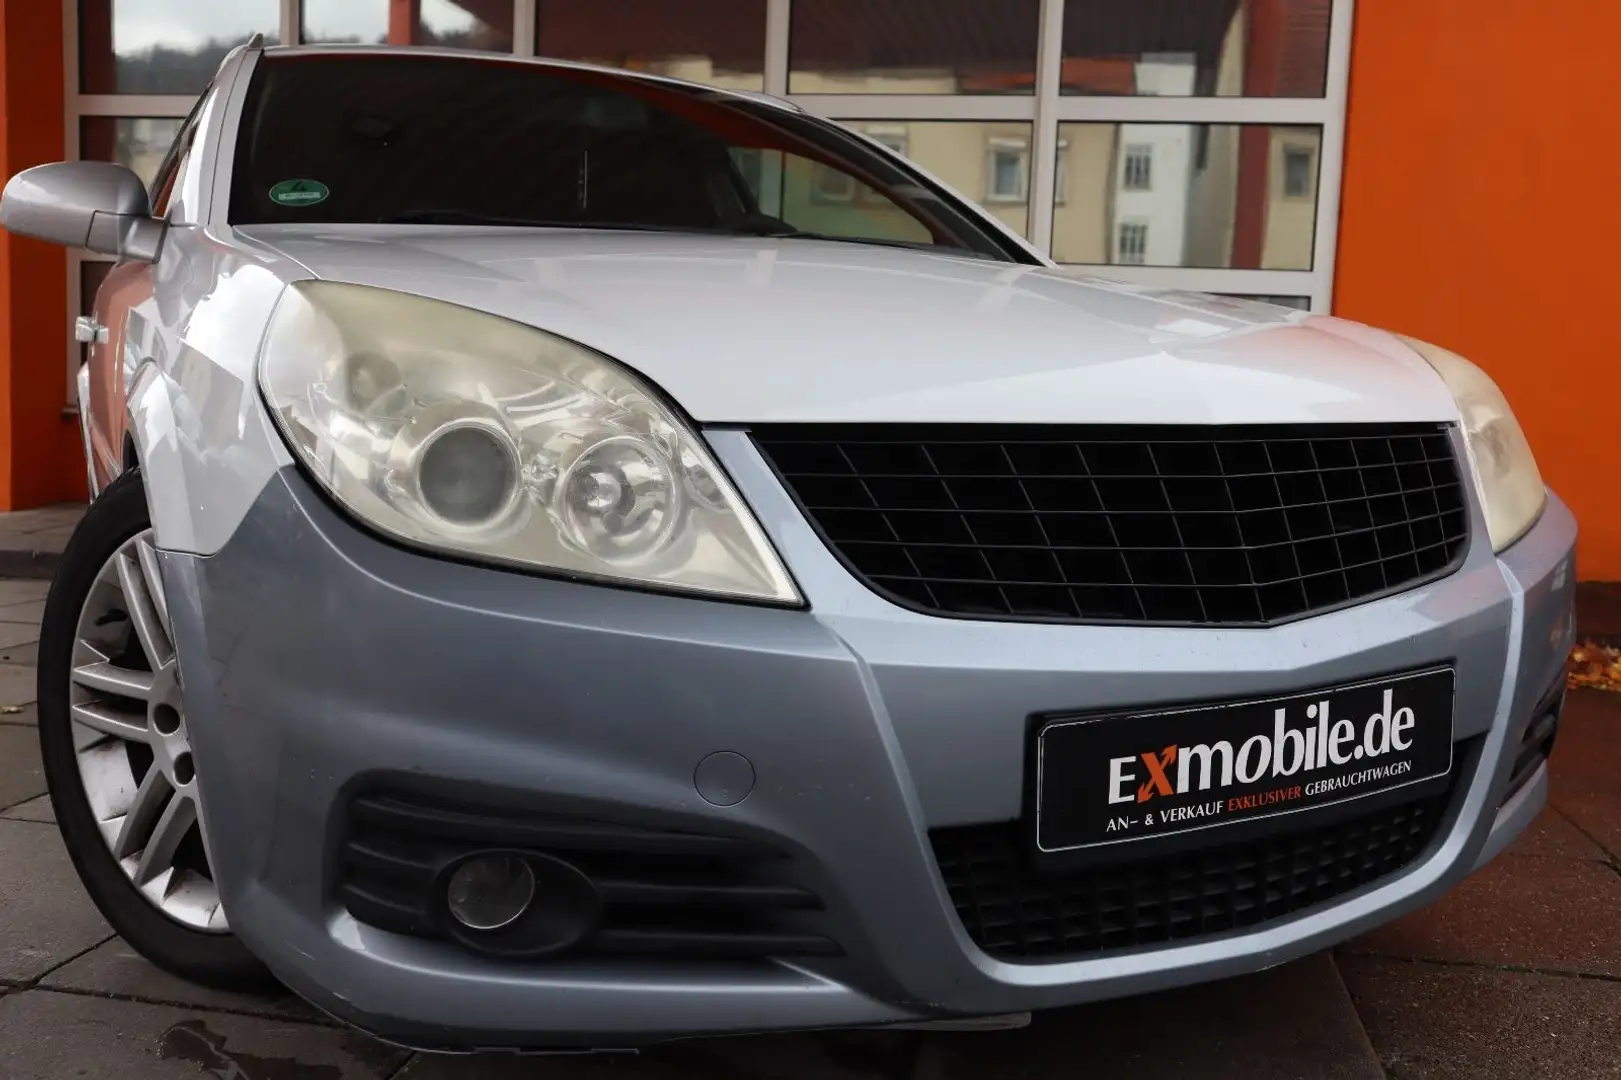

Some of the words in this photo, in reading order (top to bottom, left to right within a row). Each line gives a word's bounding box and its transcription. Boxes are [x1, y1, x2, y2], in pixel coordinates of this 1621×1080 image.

[1106, 817, 1140, 832] AN-
[1145, 814, 1154, 826] &
[1160, 800, 1224, 823] VERKAUF
[1227, 786, 1302, 812] EXKLUSIVER
[1305, 760, 1412, 796] GEBRAUCHTWAGEN
